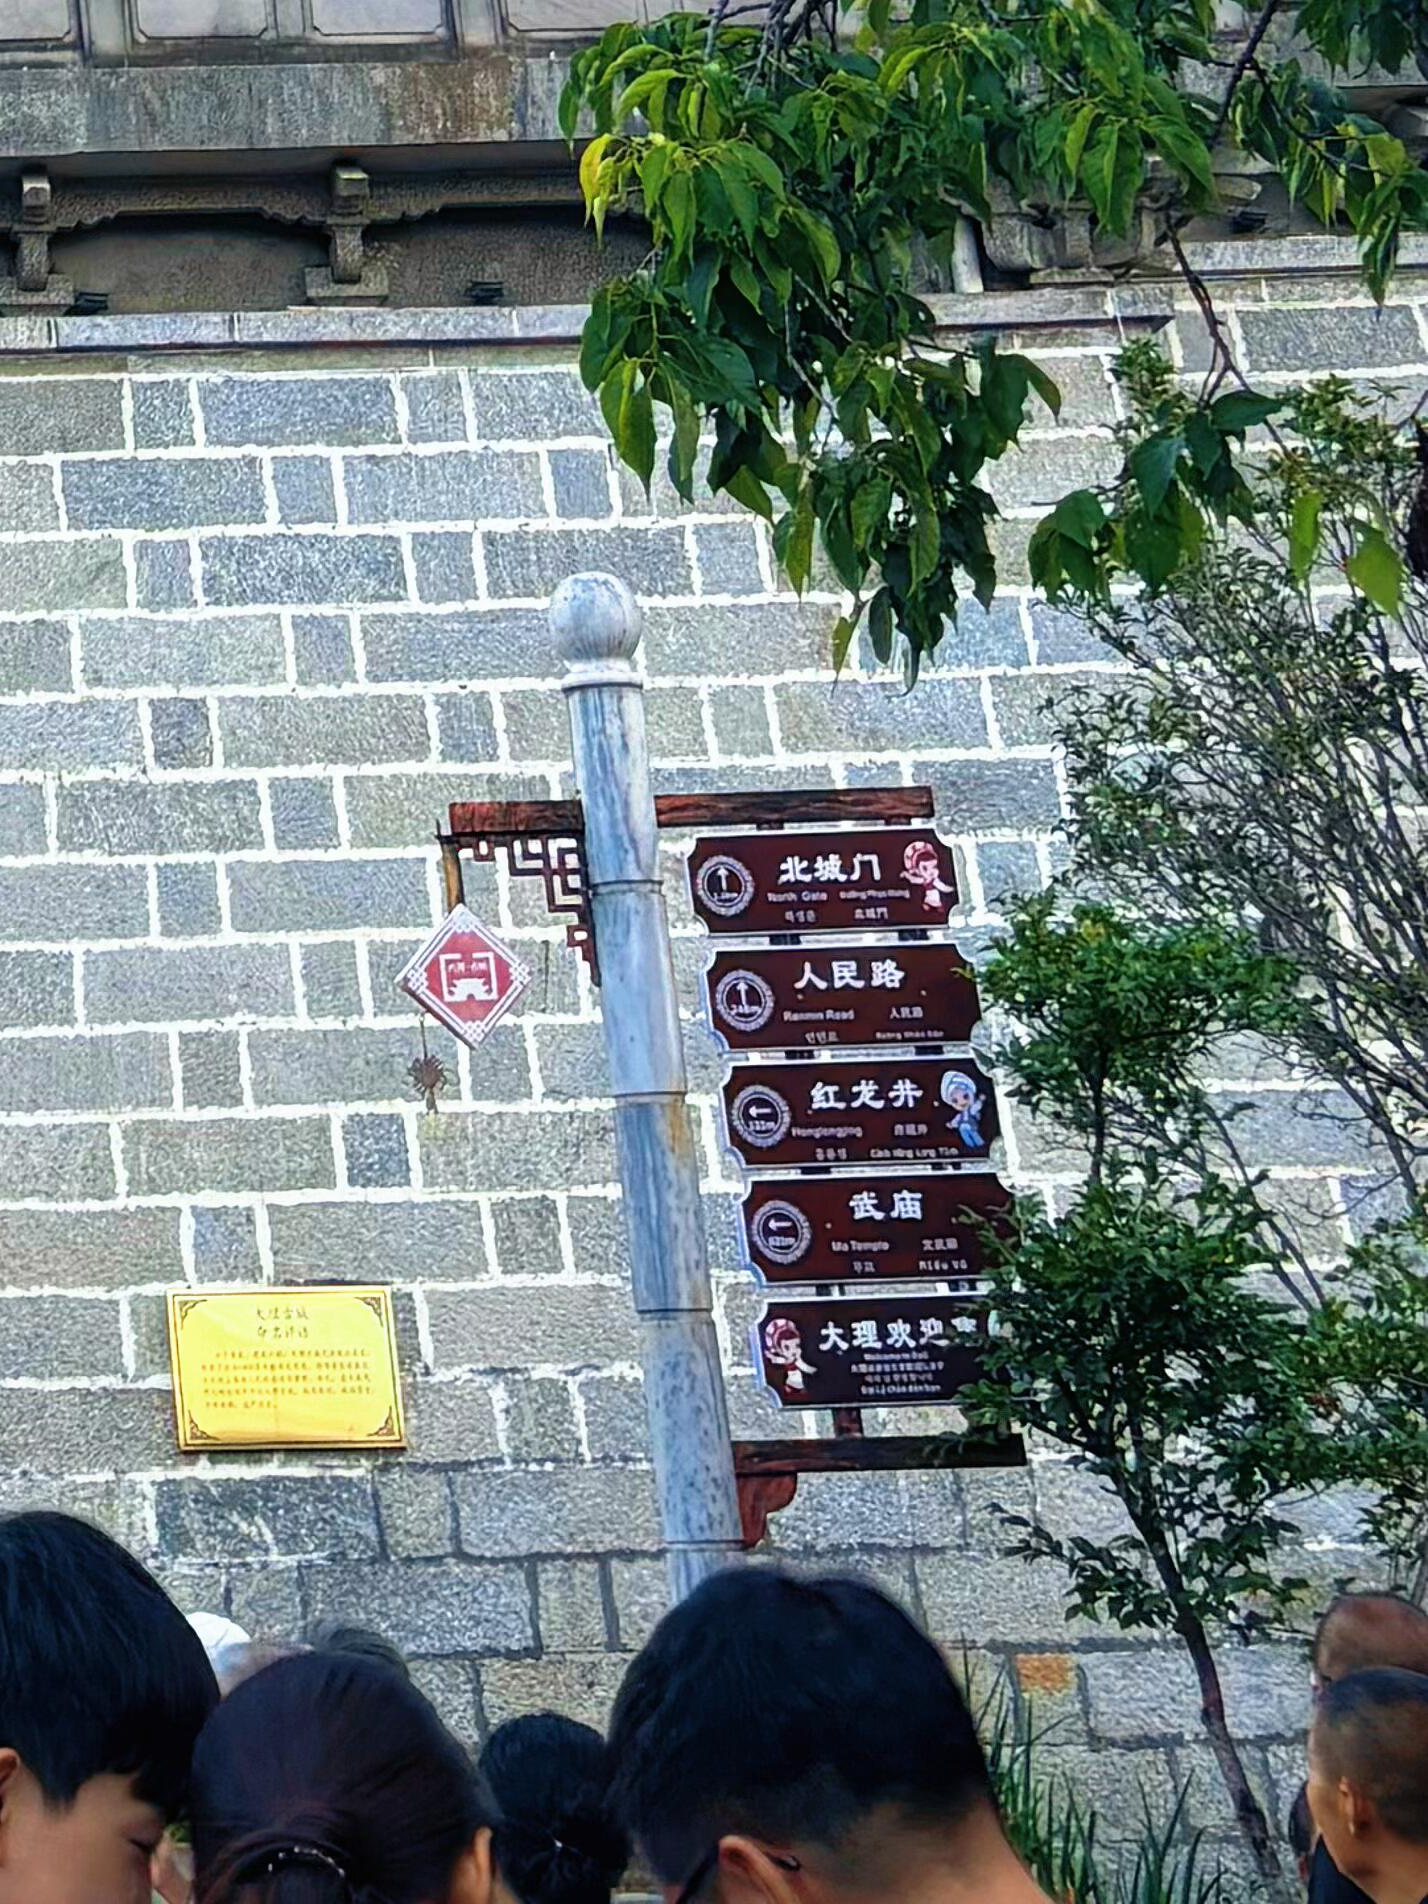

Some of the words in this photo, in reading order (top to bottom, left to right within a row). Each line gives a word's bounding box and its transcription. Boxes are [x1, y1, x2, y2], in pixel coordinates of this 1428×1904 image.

[778, 853, 882, 884] 北城门
[794, 959, 905, 990] 人民路
[811, 1078, 923, 1110] 红龙井
[849, 1189, 923, 1221] 武庙
